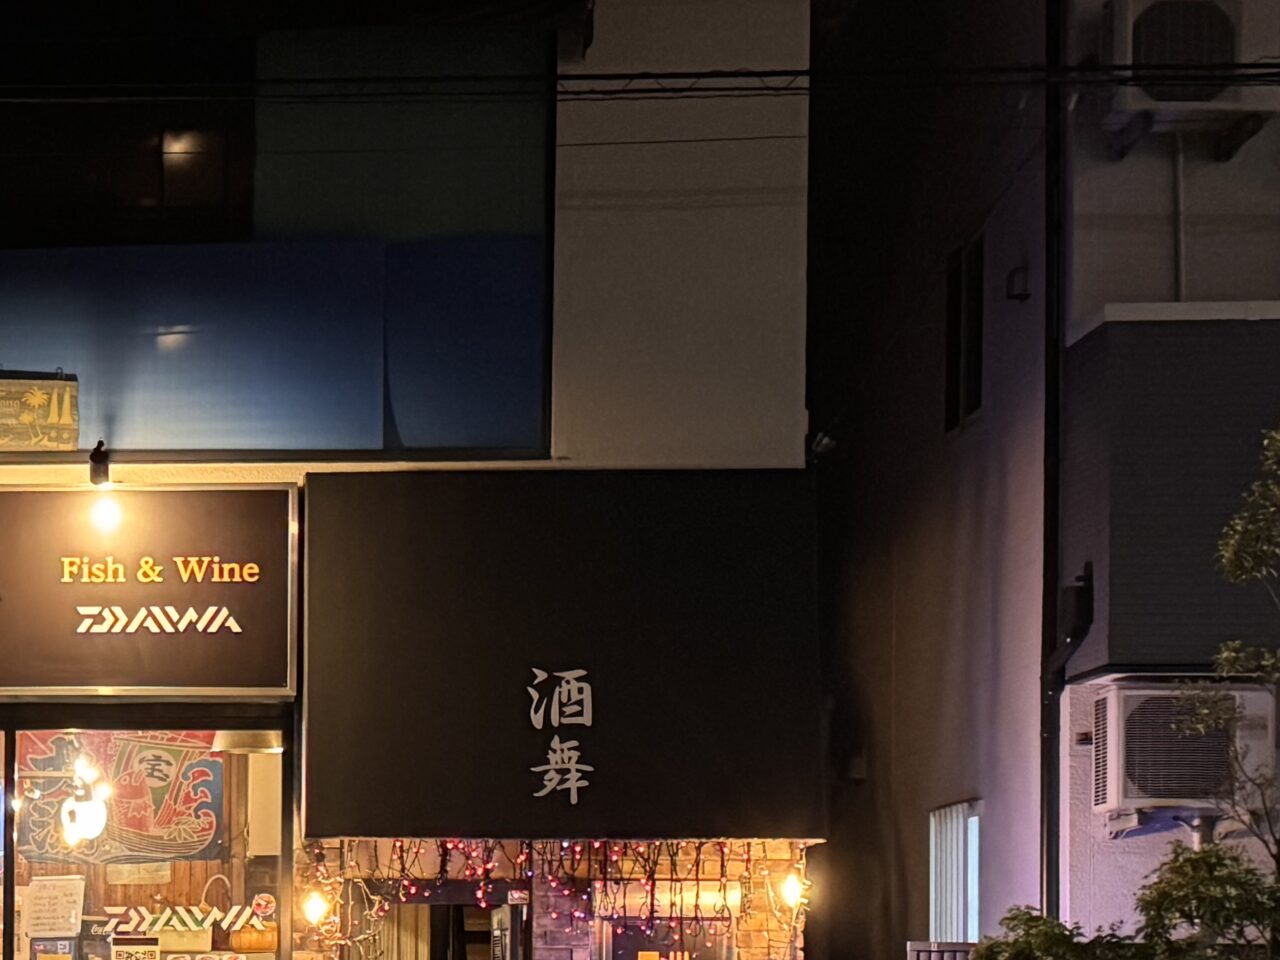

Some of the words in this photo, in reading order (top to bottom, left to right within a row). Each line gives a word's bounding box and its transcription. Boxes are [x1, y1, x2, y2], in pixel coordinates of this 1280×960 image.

[60, 556, 125, 584] Fish
[137, 557, 163, 584] &
[172, 556, 260, 584] Wine
[526, 667, 594, 805] 酒舞
